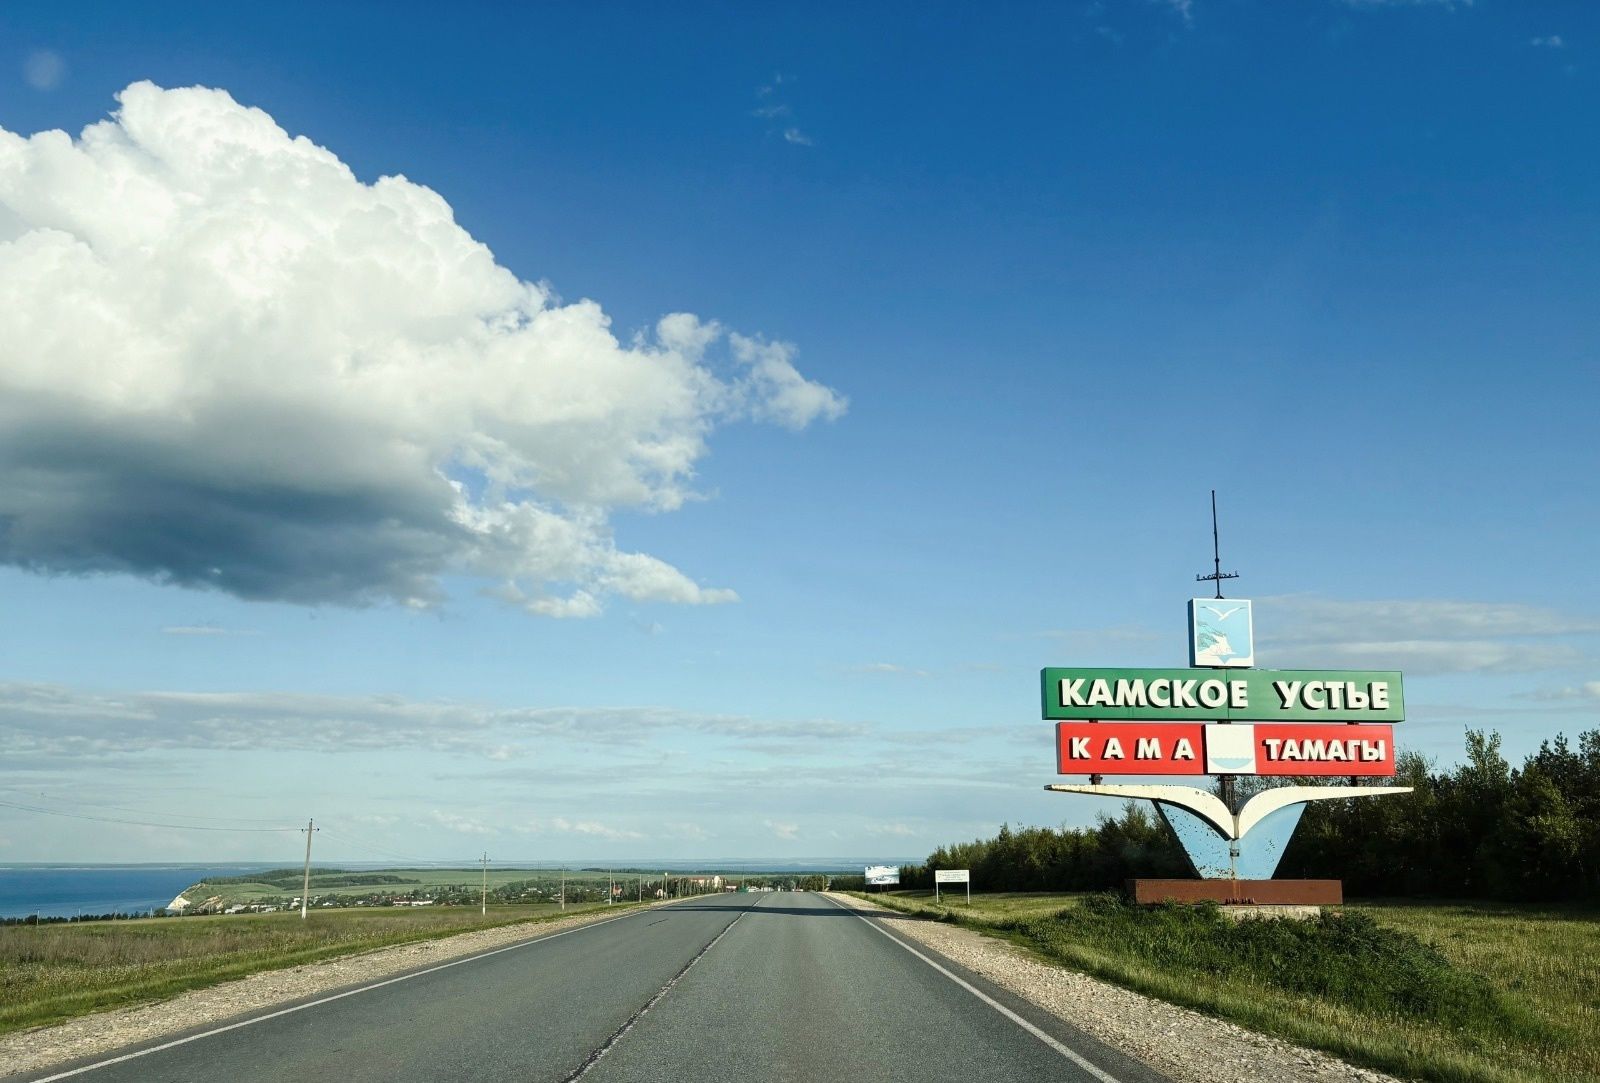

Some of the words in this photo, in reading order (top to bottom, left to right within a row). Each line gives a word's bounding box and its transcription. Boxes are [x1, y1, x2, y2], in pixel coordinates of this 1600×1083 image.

[1060, 678, 1248, 709] КАМСКОЕ
[1274, 680, 1390, 710] УСТЬЕ
[1070, 737, 1196, 760] КАМА
[1264, 738, 1386, 762] ТАМАГЫ
